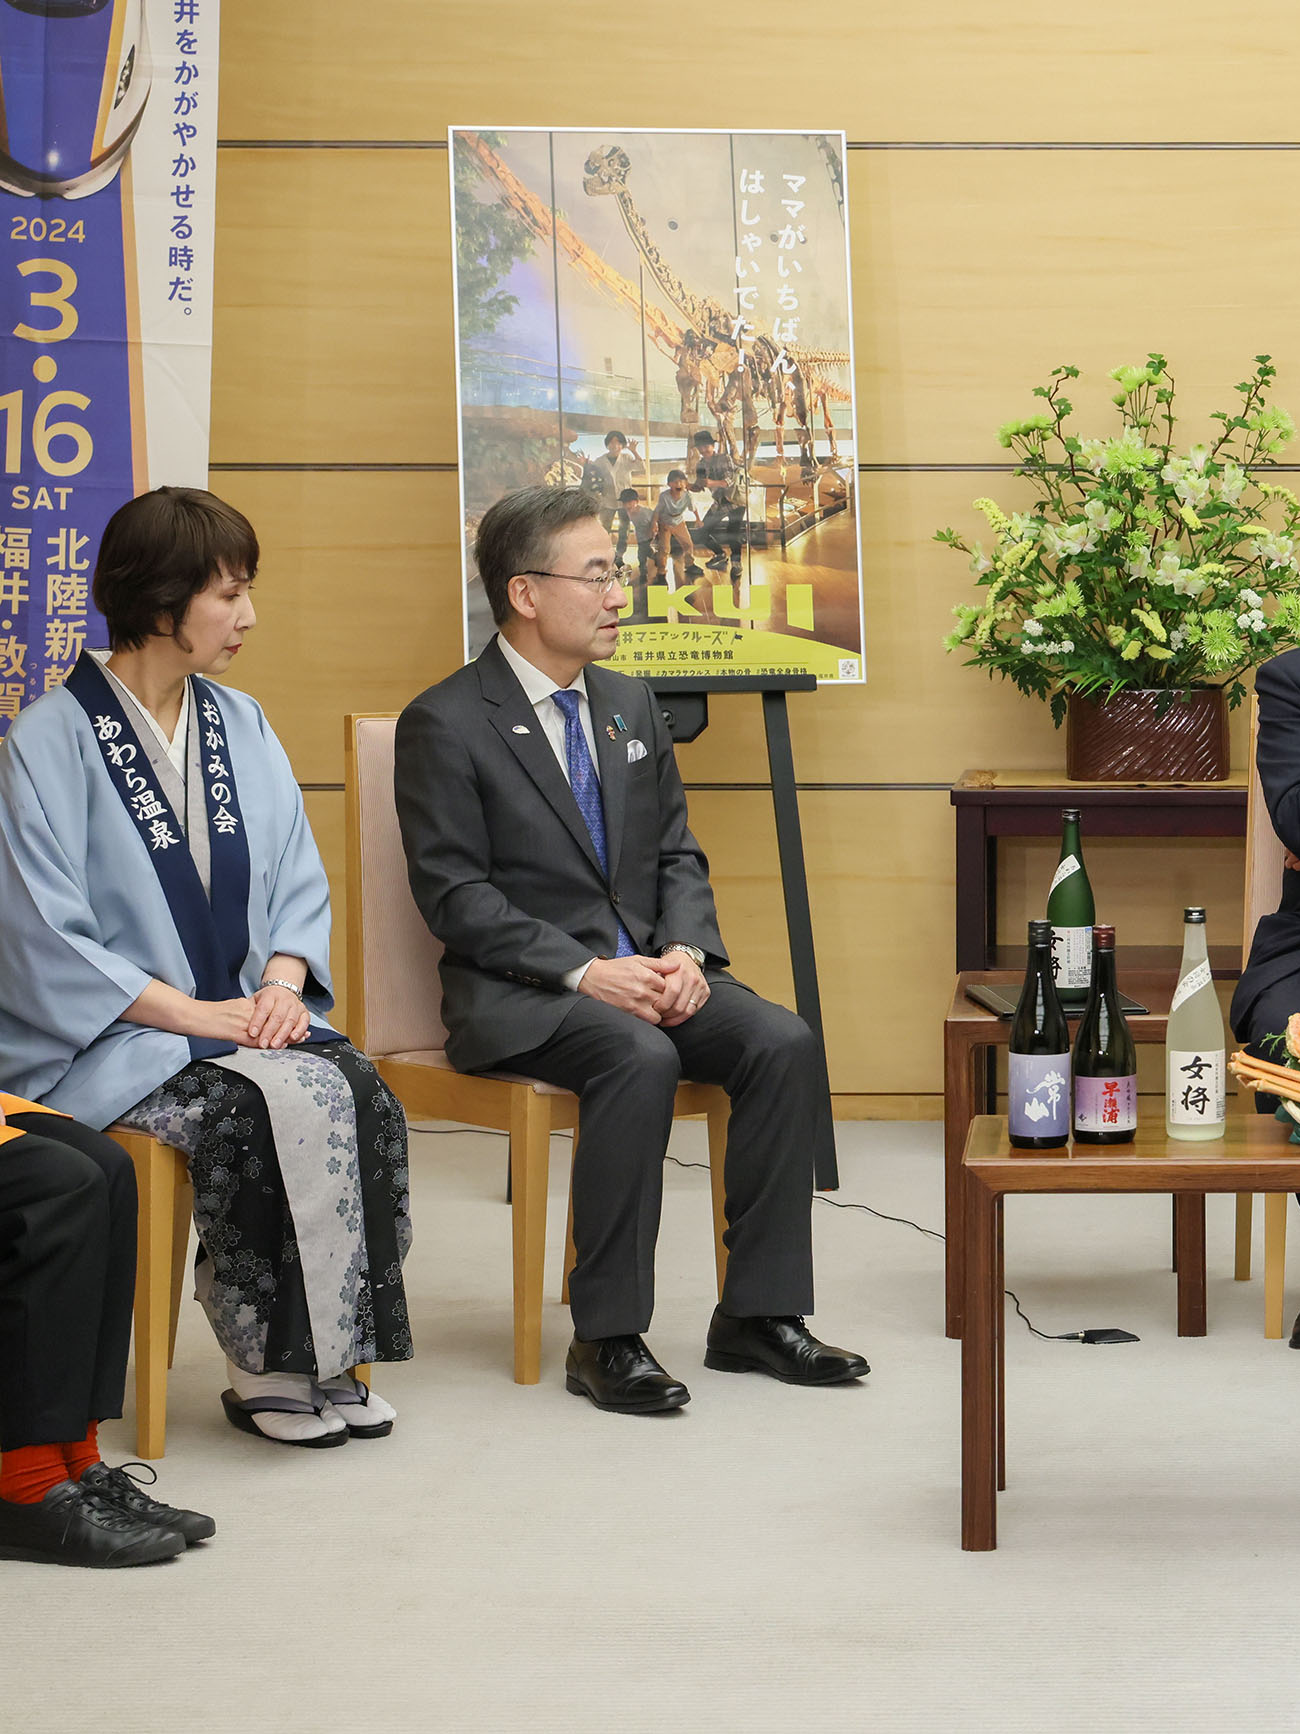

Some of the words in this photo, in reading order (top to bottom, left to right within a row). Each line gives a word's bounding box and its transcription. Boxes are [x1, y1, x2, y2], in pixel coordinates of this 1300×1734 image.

[10, 216, 86, 243] 2024
[770, 174, 807, 391] ママがいちばん、
[11, 485, 73, 511] SAT
[616, 630, 729, 646] 井マニアックルーズ
[633, 650, 734, 661] 福井県立恐竜博物館
[93, 715, 180, 850] あわら温泉
[202, 699, 239, 834] おかみの会
[1102, 1081, 1120, 1124] 早瀬浦
[1180, 1056, 1212, 1115] 女将
